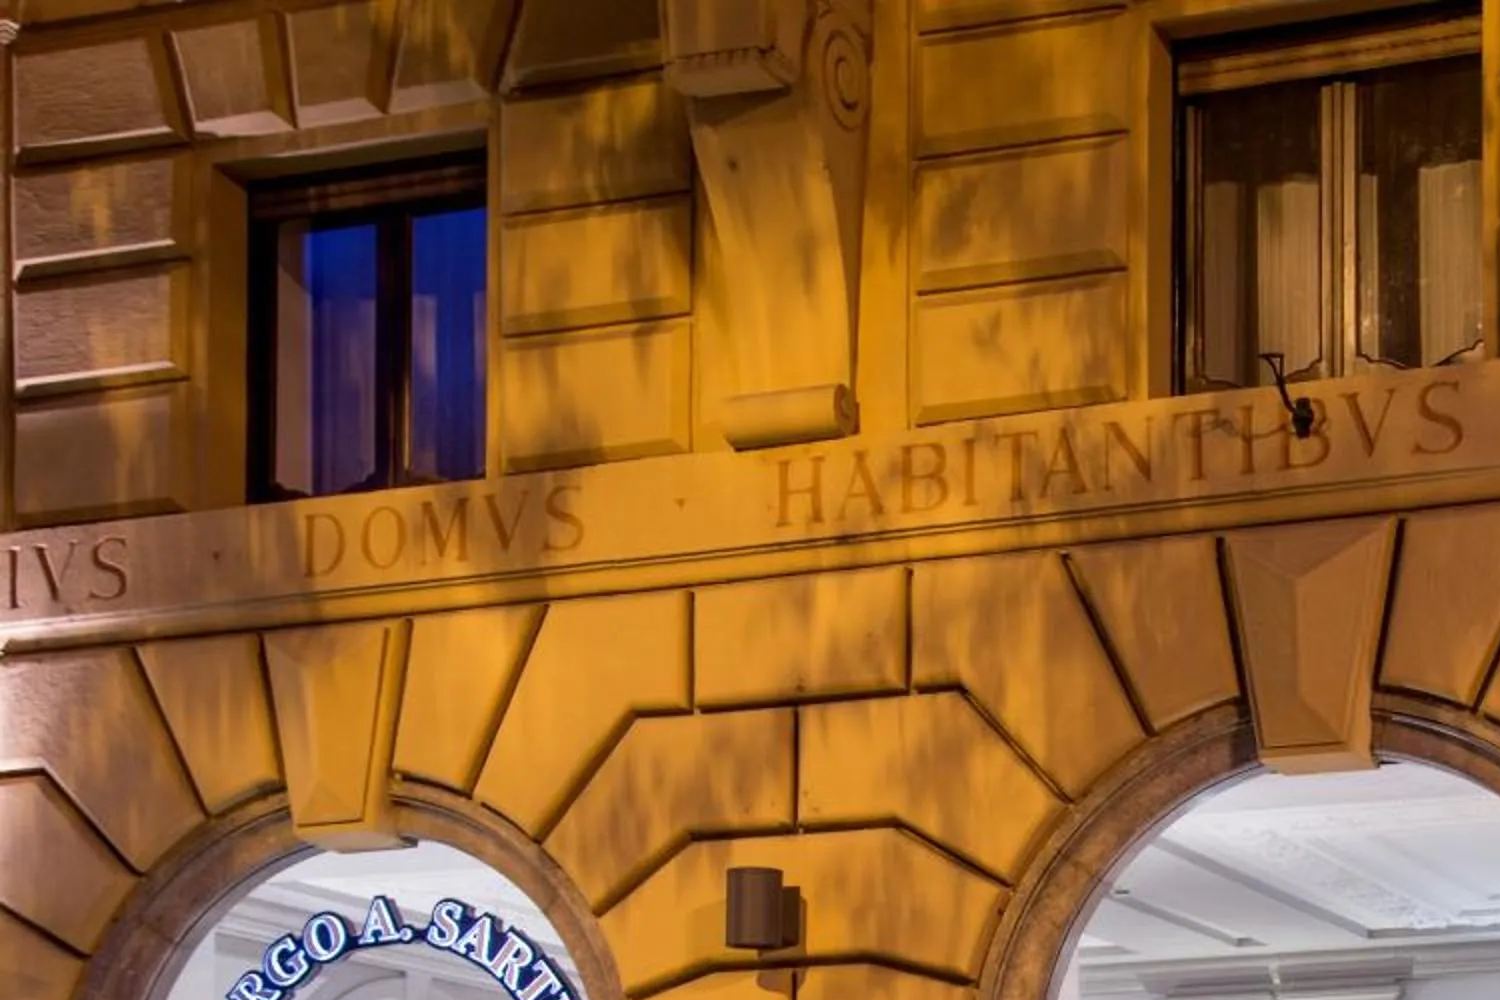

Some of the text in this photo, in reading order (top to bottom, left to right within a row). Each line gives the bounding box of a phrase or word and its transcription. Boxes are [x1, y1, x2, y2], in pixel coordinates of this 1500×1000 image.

[7, 536, 128, 610] IVS
[302, 485, 586, 578] DOMVS
[772, 380, 1464, 528] HABITANTIBVS
[355, 896, 415, 947] A.
